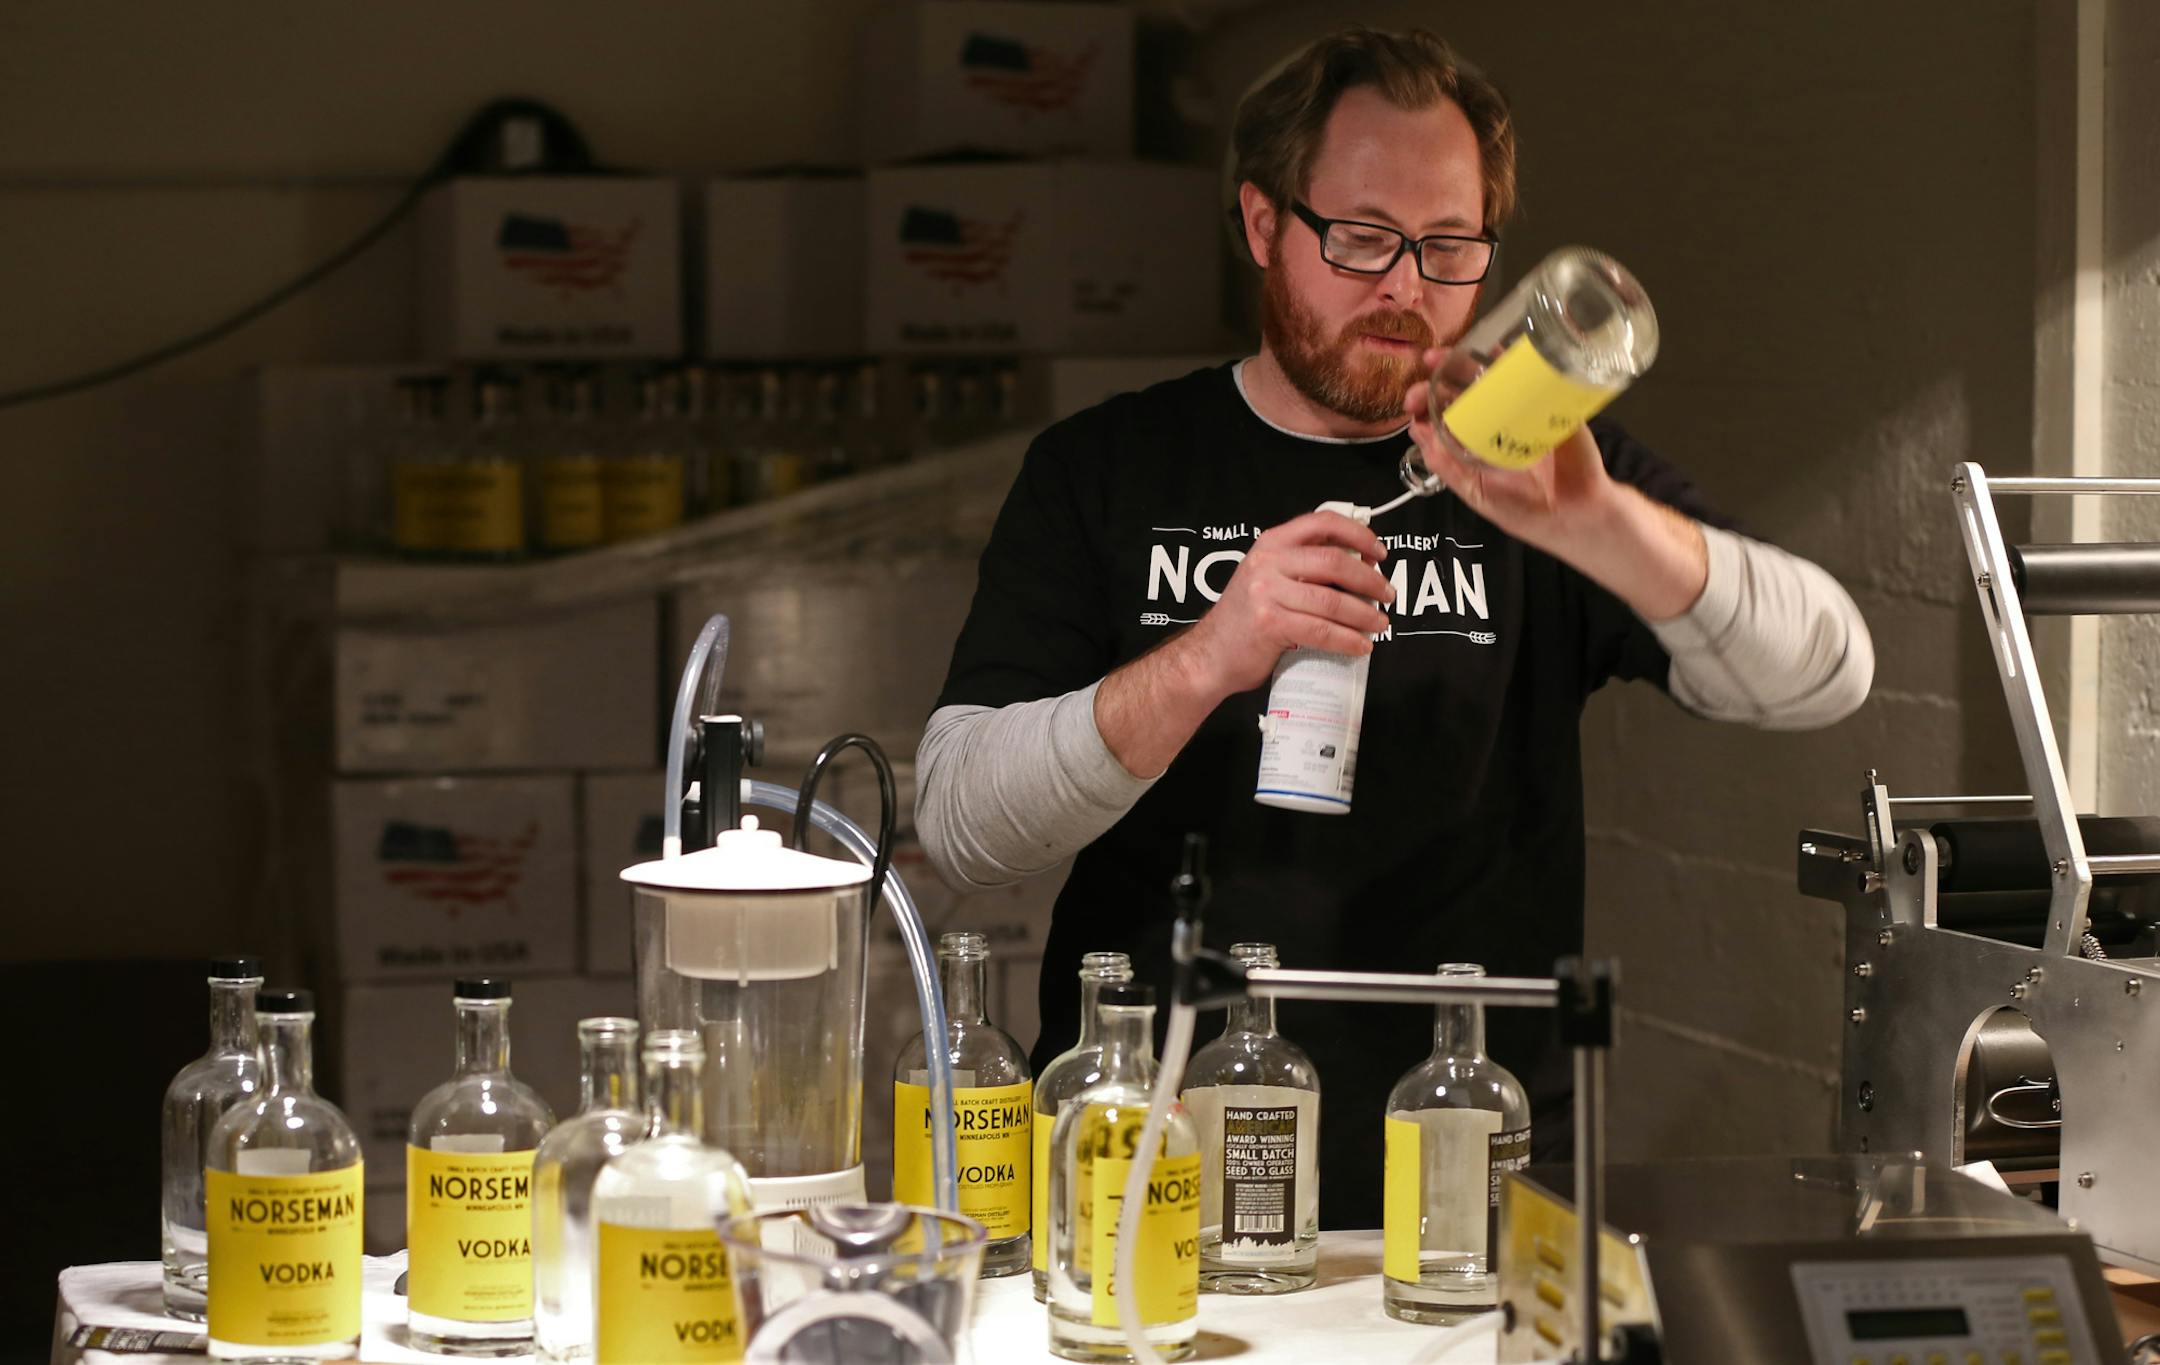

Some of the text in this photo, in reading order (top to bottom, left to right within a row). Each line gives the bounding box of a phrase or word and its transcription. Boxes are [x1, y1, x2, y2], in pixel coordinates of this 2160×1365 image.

[1202, 522, 1249, 541] SMALL
[1376, 532, 1440, 551] TILLERY
[1226, 1110, 1295, 1120] HAND CRAFTED
[1226, 1134, 1295, 1144] AWARD WINNING
[1491, 1134, 1513, 1145] HAND
[1226, 1149, 1295, 1160] SMALL BATCH
[1225, 1165, 1294, 1176] SEED TO GLASS
[430, 1174, 528, 1200] NORSEM
[231, 1193, 355, 1224] NORSEMAN
[458, 1237, 531, 1258] VODKA
[259, 1262, 334, 1285] VODKA
